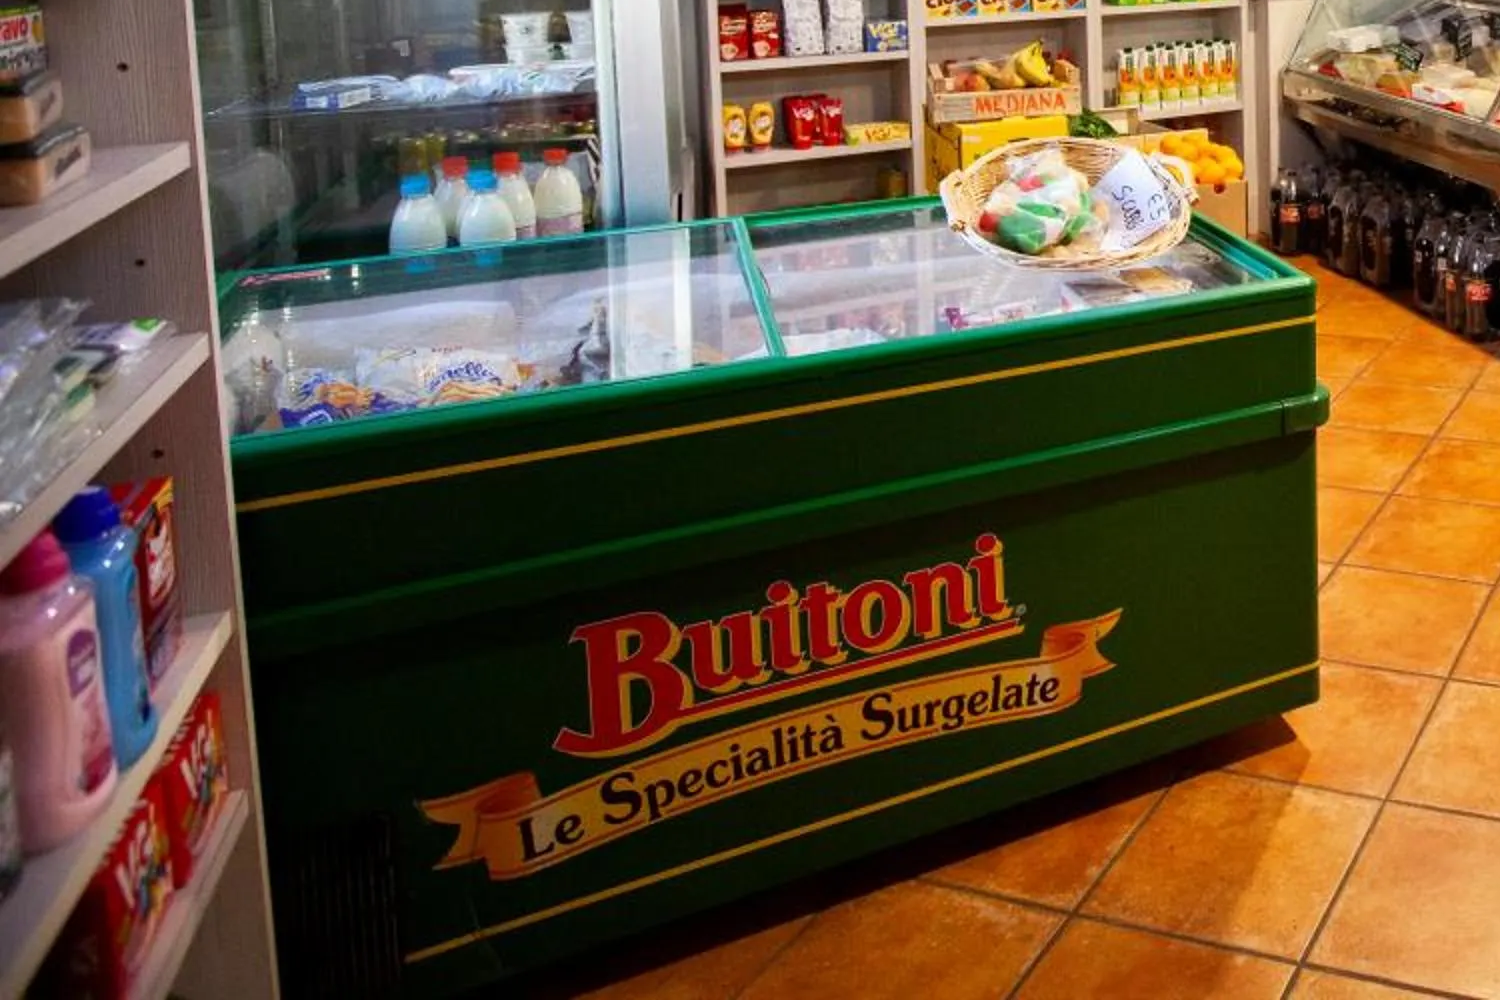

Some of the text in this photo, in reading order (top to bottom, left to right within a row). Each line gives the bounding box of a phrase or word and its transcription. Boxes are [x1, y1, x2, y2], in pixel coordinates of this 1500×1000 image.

[975, 91, 1066, 115] MEDIANA
[552, 533, 1010, 758] Buitoni
[517, 672, 1060, 863] Le Specialità Surgelate
